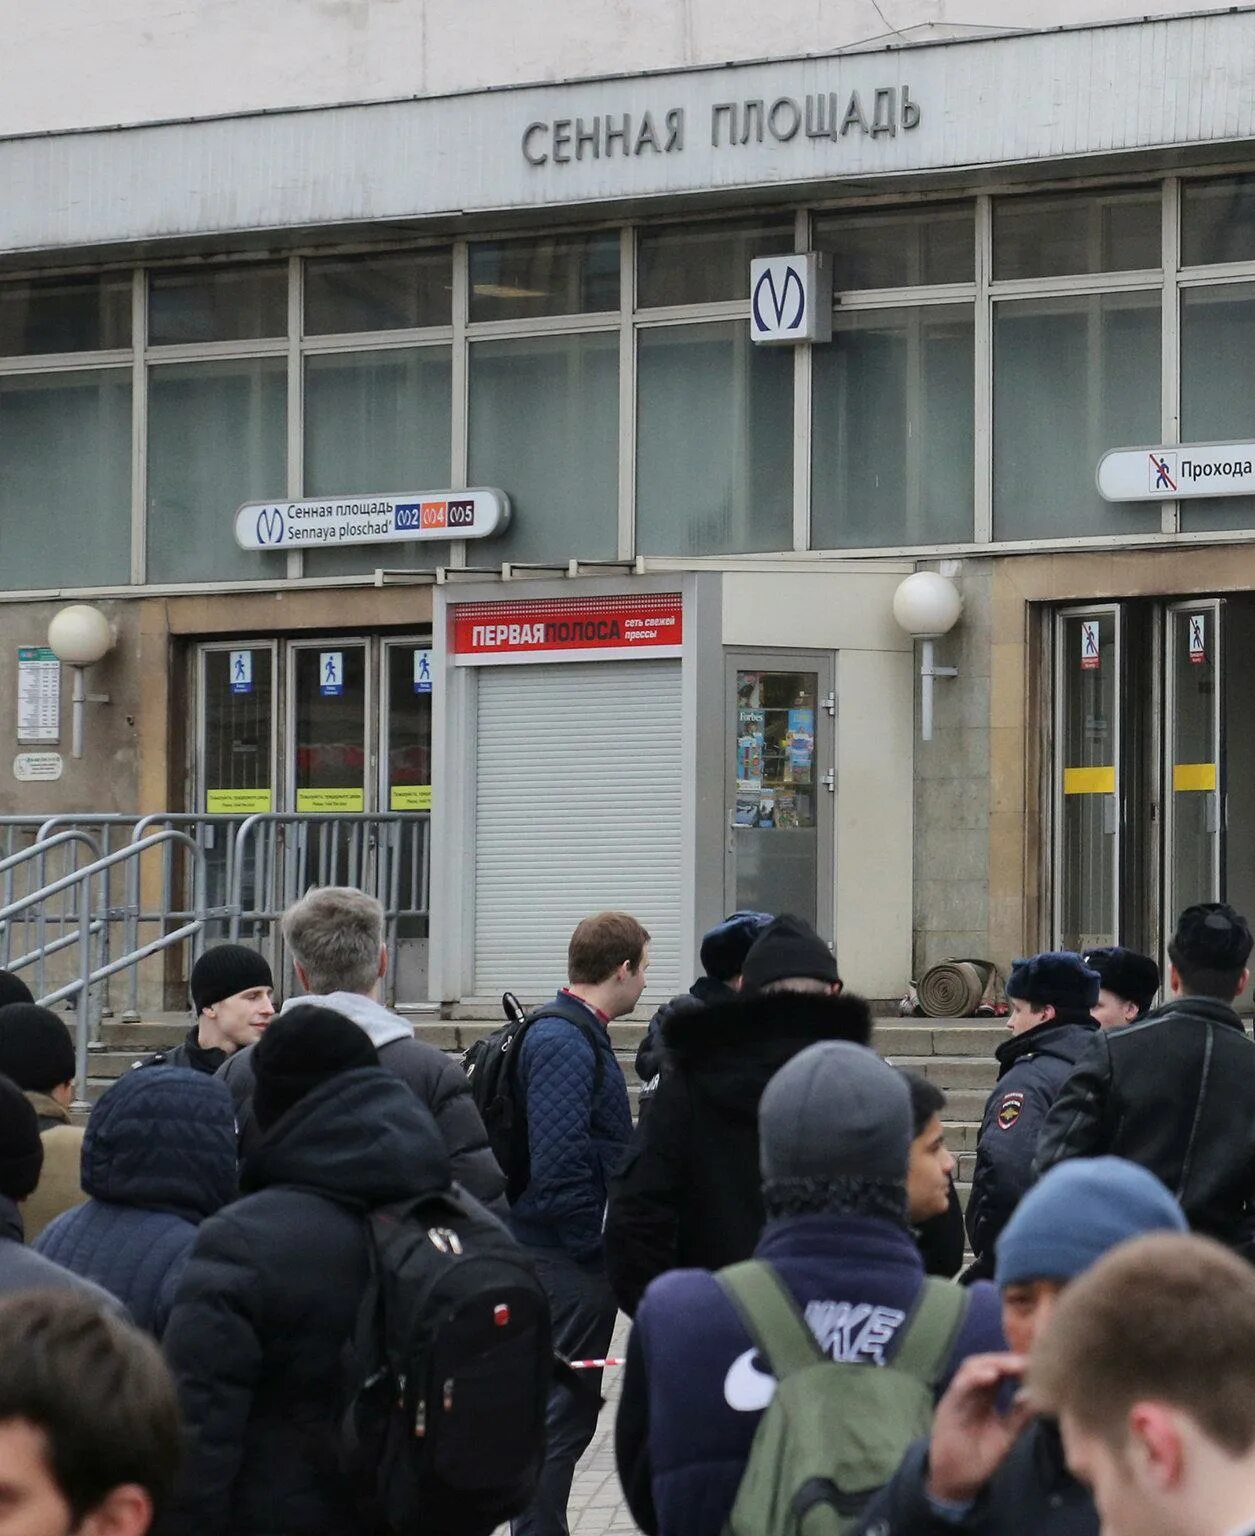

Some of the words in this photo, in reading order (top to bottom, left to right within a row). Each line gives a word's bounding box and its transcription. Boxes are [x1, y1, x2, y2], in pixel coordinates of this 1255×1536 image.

[521, 107, 685, 166] СЕННАЯ
[711, 85, 921, 148] ПЛОЩАДЬ
[1181, 460, 1253, 482] Прохода
[287, 504, 333, 519] Сенная
[336, 501, 393, 517] площадь
[288, 523, 336, 541] Sennaya
[739, 711, 764, 722] Forbes
